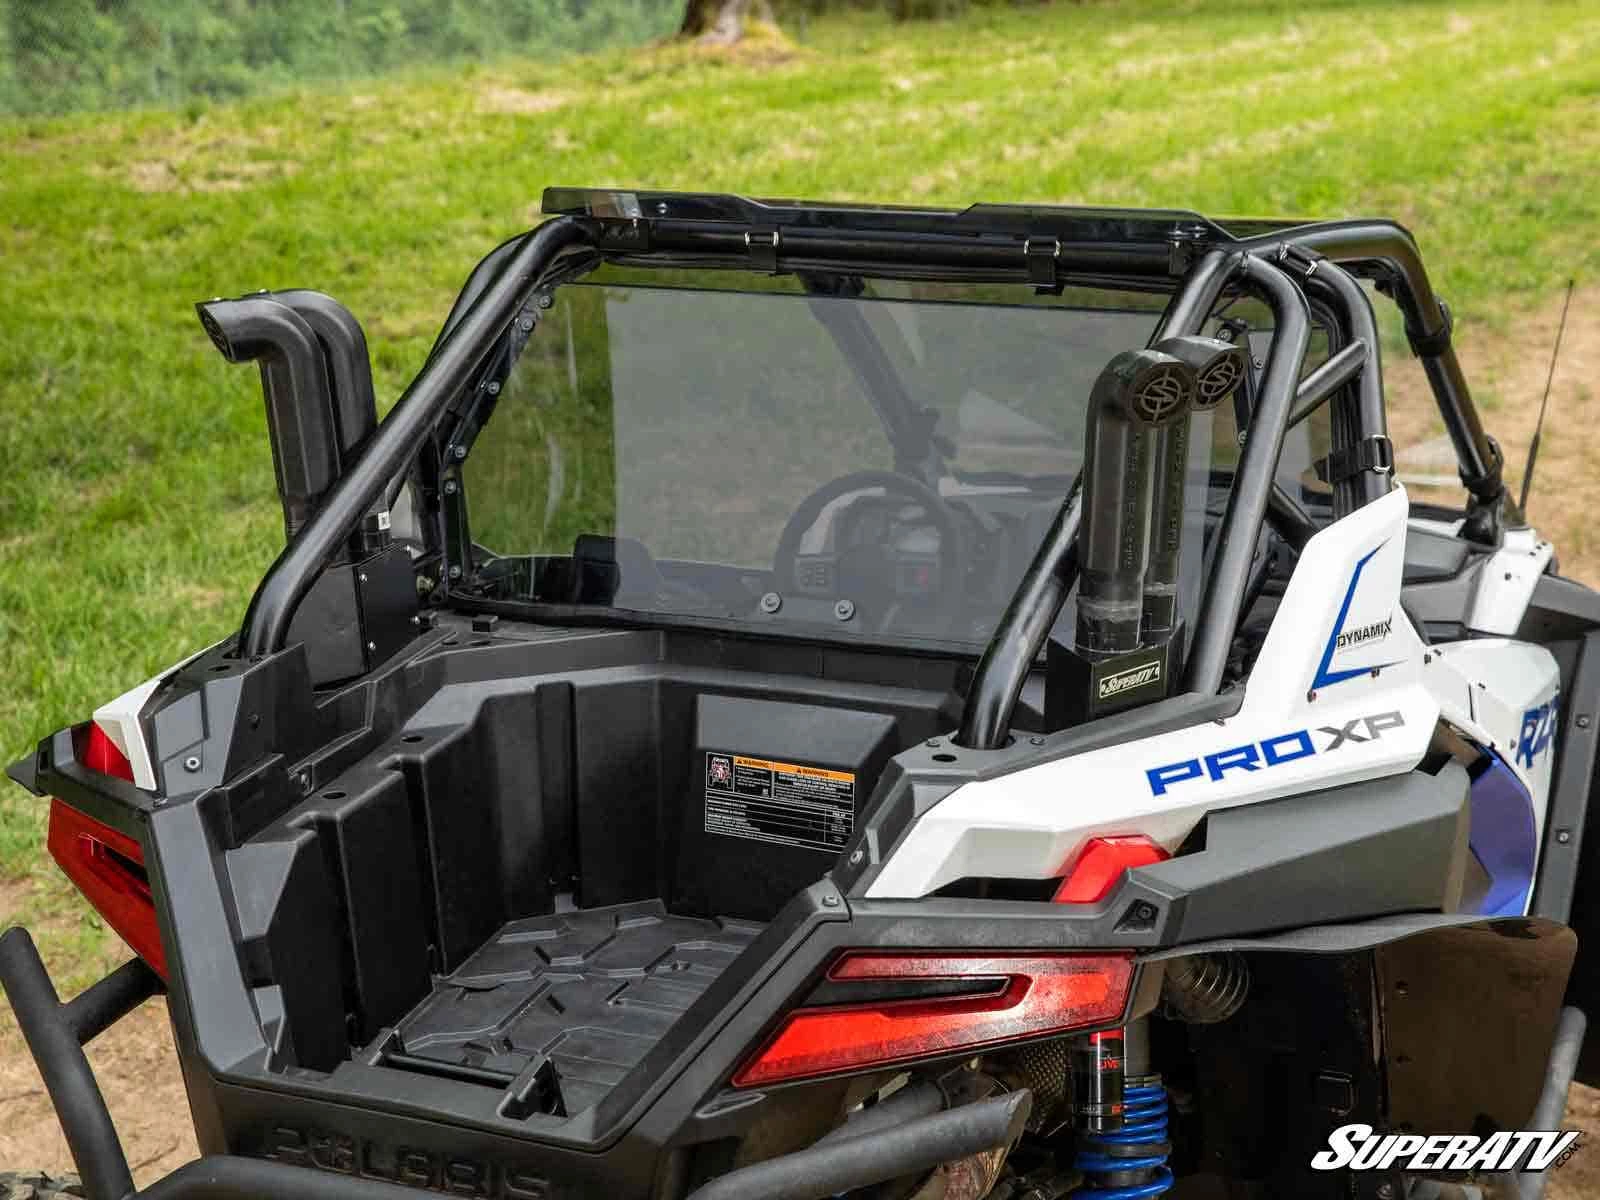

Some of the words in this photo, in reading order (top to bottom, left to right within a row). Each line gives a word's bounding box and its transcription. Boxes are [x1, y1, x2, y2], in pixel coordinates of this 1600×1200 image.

[1337, 611, 1393, 648] DYNAMIX
[1145, 729, 1317, 797] PRO
[1316, 710, 1405, 752] XP
